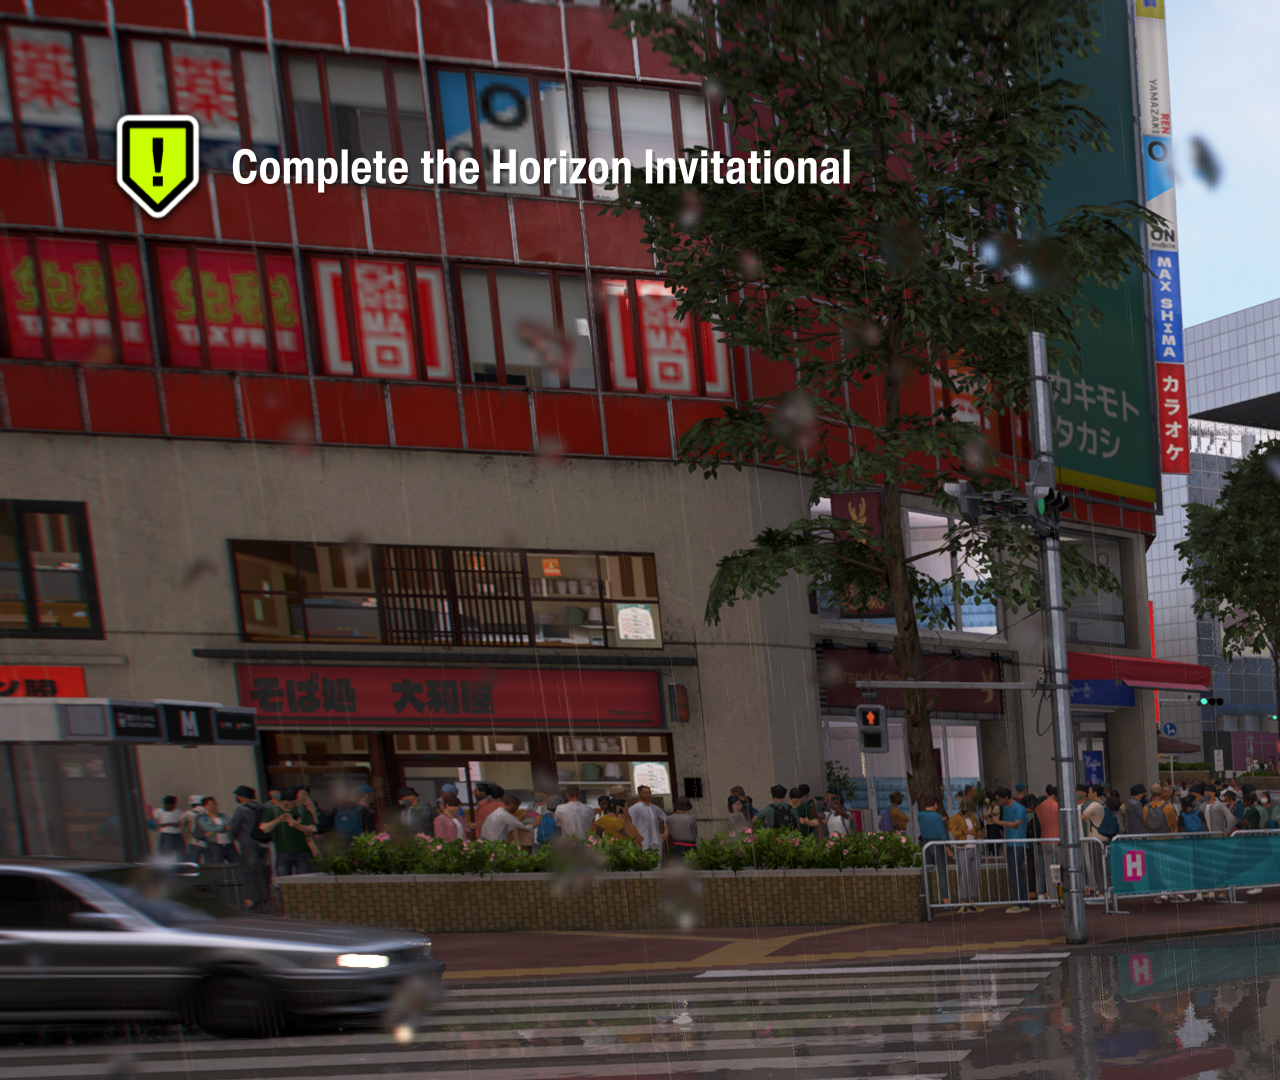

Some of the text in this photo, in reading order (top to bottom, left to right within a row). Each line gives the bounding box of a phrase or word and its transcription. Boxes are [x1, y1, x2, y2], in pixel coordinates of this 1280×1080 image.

[1148, 79, 1161, 135] YAMAZAKI
[1160, 113, 1171, 135] REN
[1151, 240, 1176, 250] mobile
[1157, 256, 1177, 358] MAX SHIMA
[1051, 370, 1140, 423] カキモト
[1162, 375, 1185, 462] カラオケ
[1055, 414, 1121, 460] タカシ
[250, 672, 496, 716] そば処 大和屋
[1125, 853, 1142, 878] H
